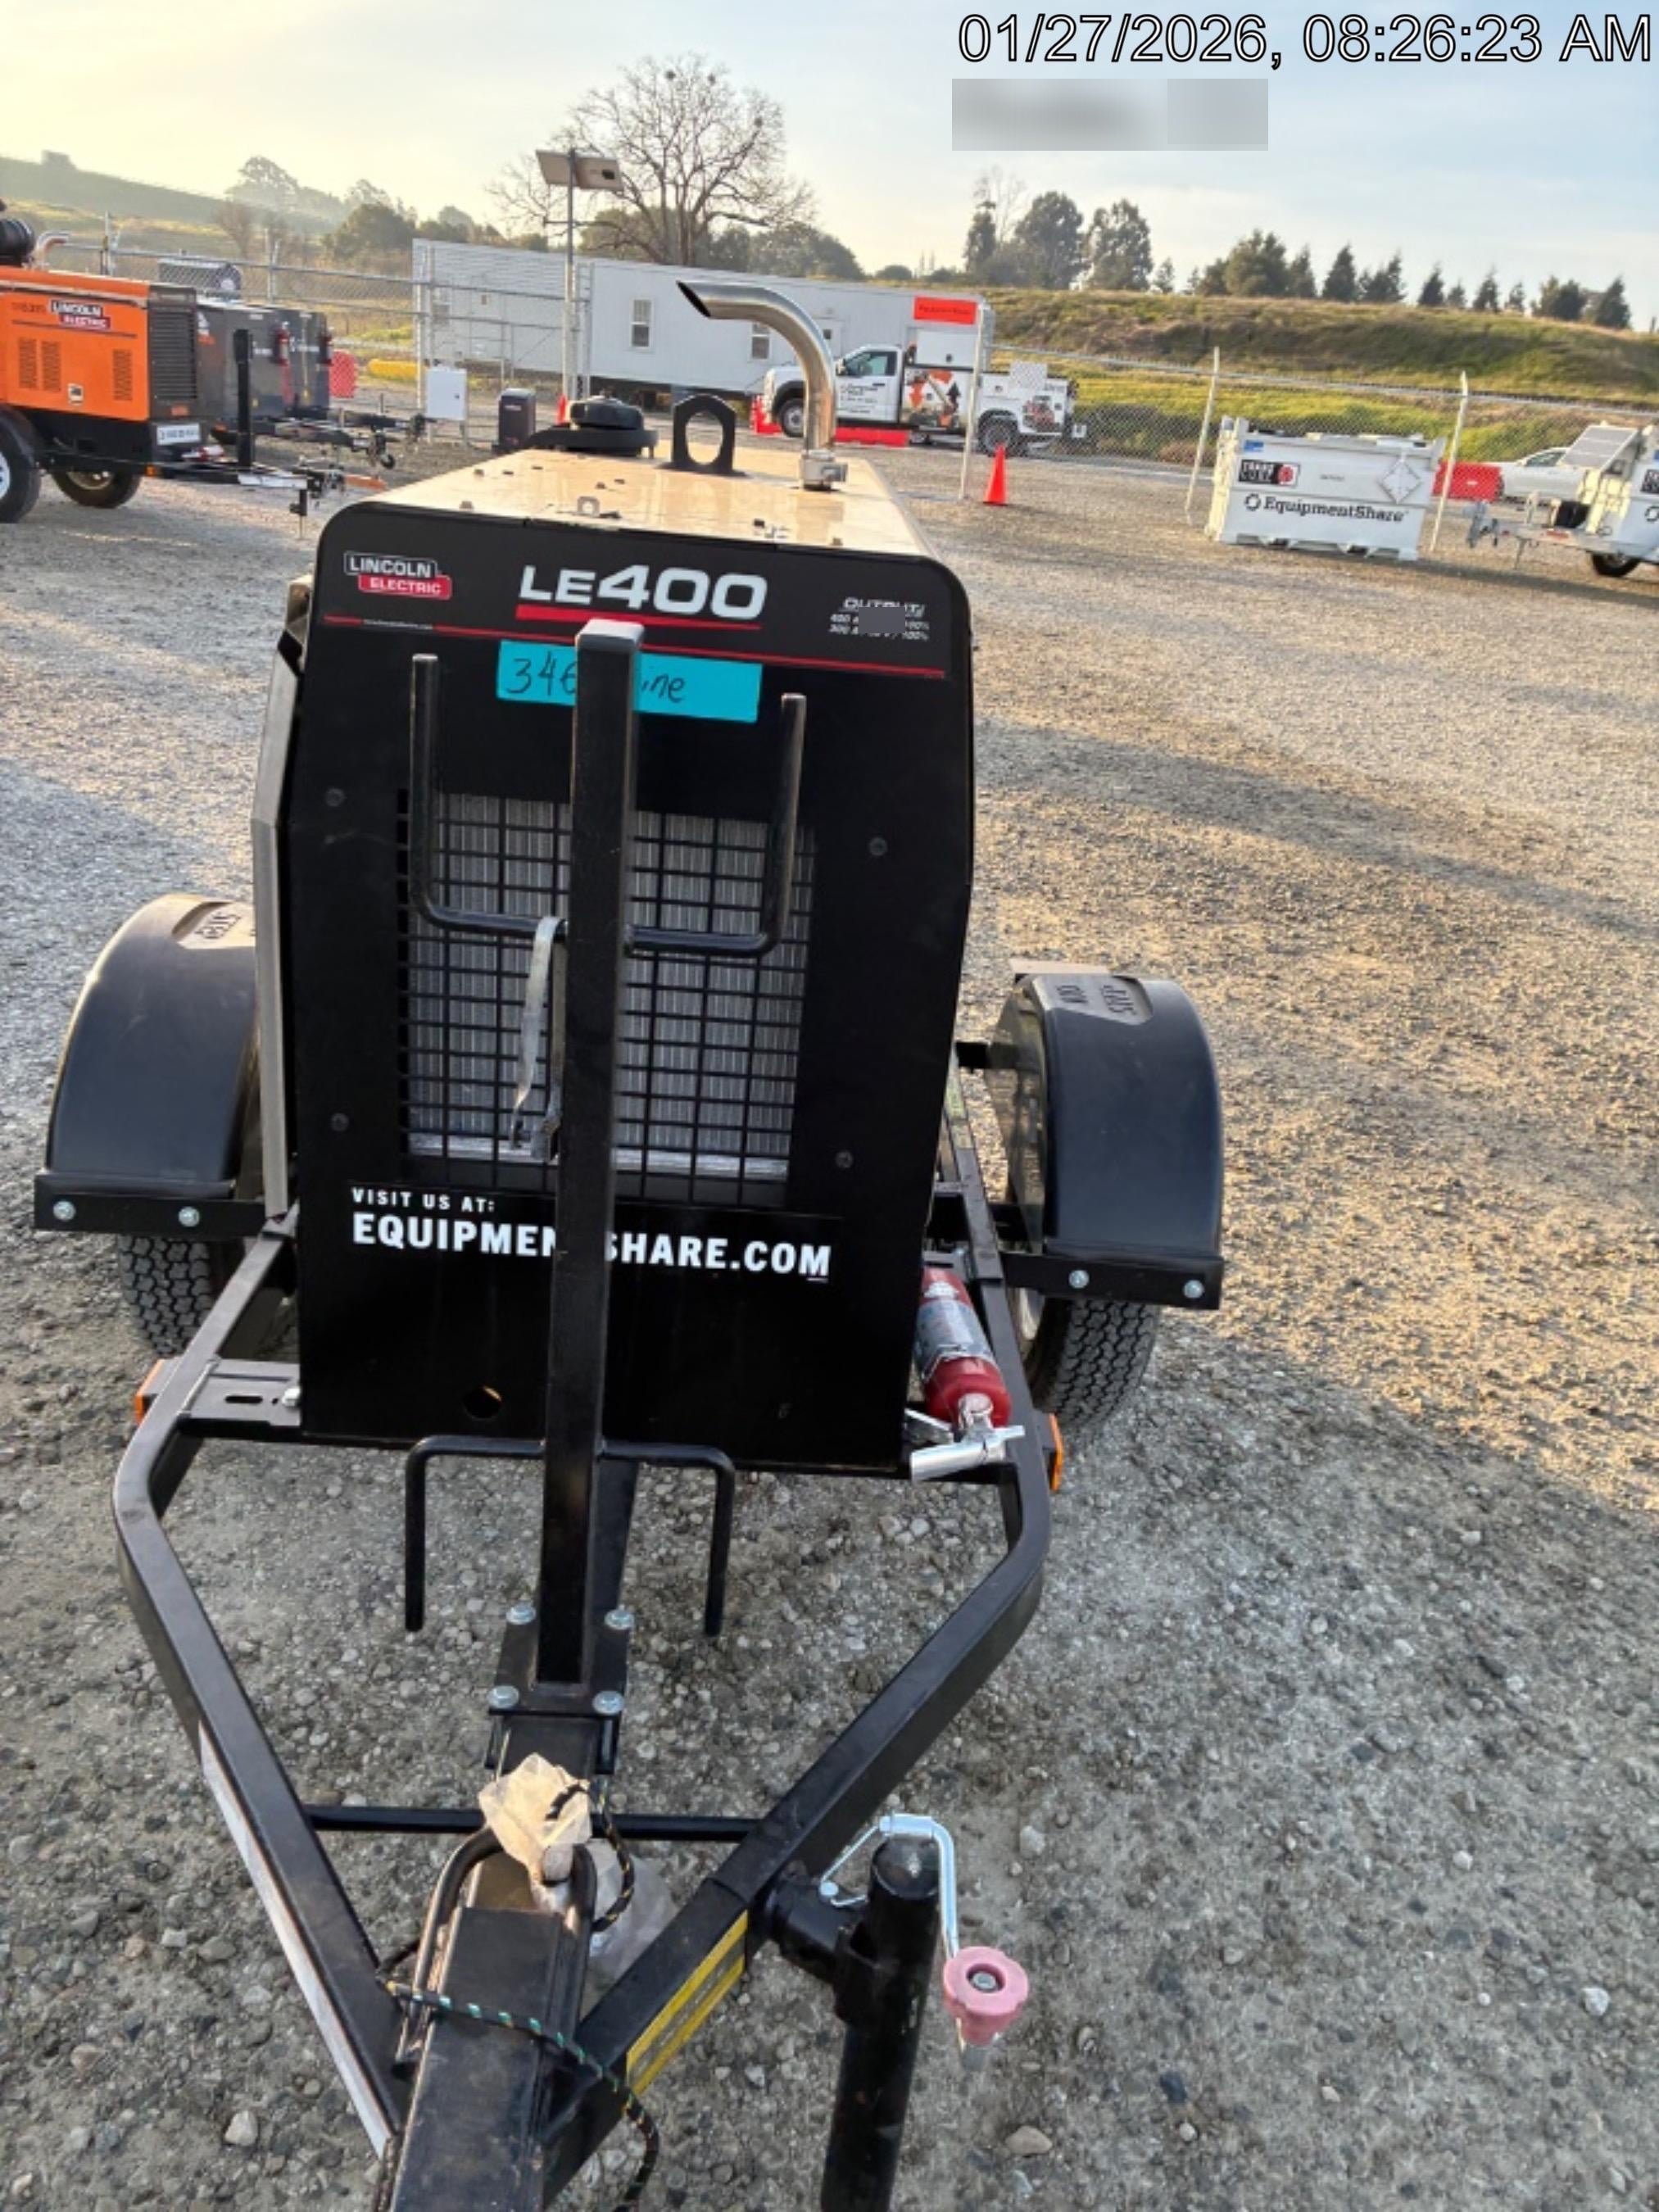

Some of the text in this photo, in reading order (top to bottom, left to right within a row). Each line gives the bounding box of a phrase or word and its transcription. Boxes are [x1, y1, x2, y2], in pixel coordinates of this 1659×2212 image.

[1264, 496, 1404, 523] EquipmentShare
[350, 556, 432, 578] LINCOLN
[369, 577, 442, 595] ELECTRIC
[518, 564, 768, 620] LE400
[351, 1188, 495, 1213] VISIT US AT:
[352, 1210, 832, 1276] EQUIPMENSHARE.COM
